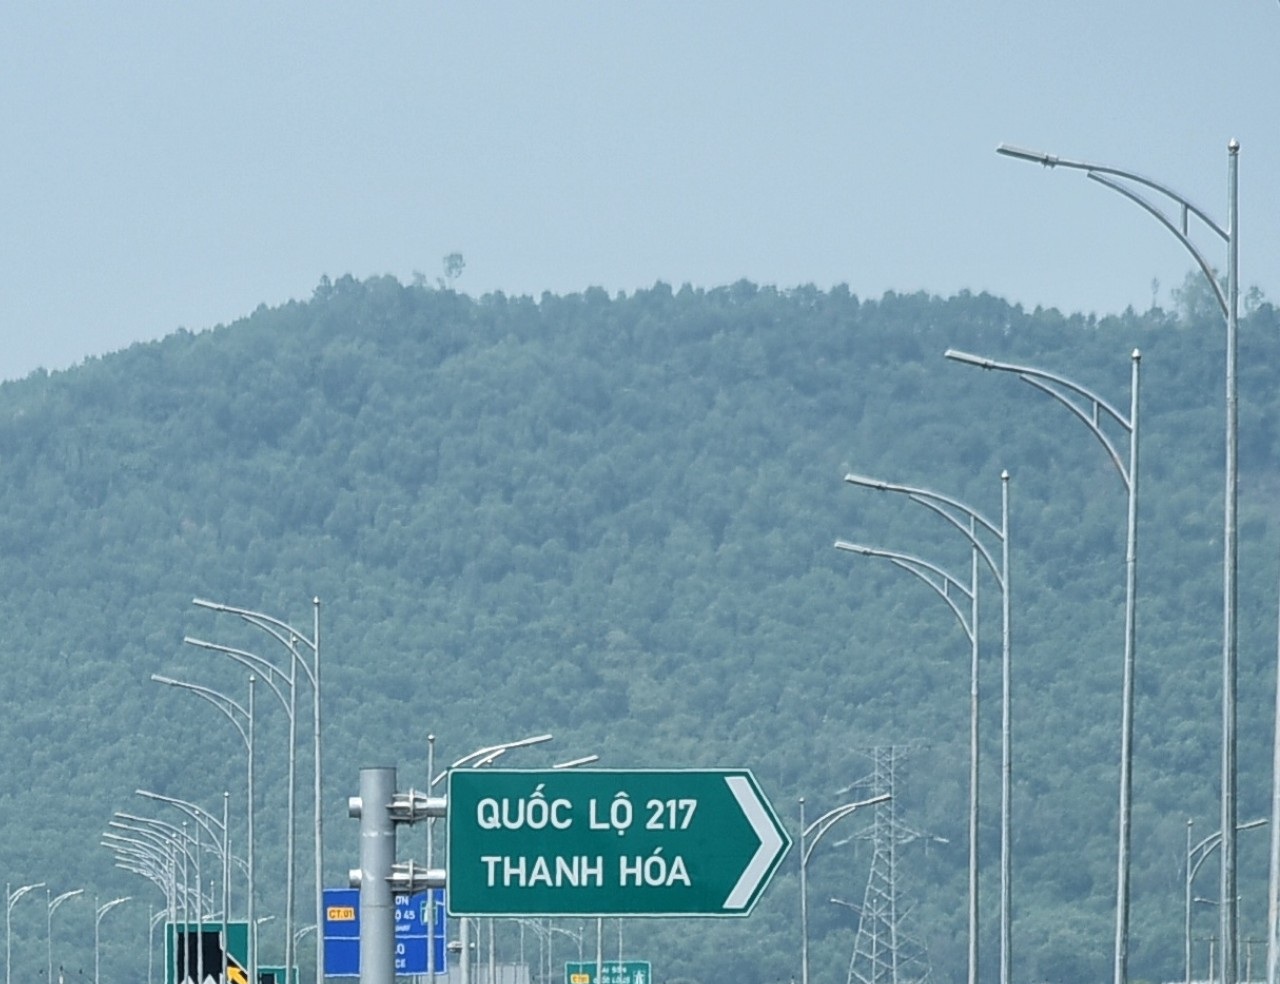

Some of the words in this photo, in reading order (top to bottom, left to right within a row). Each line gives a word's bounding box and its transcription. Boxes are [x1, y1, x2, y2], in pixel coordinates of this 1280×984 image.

[476, 784, 573, 831] QUỐC
[589, 791, 634, 837] LỘ
[645, 797, 698, 831] 217
[480, 854, 603, 888] THANH
[619, 847, 692, 888] HÓA
